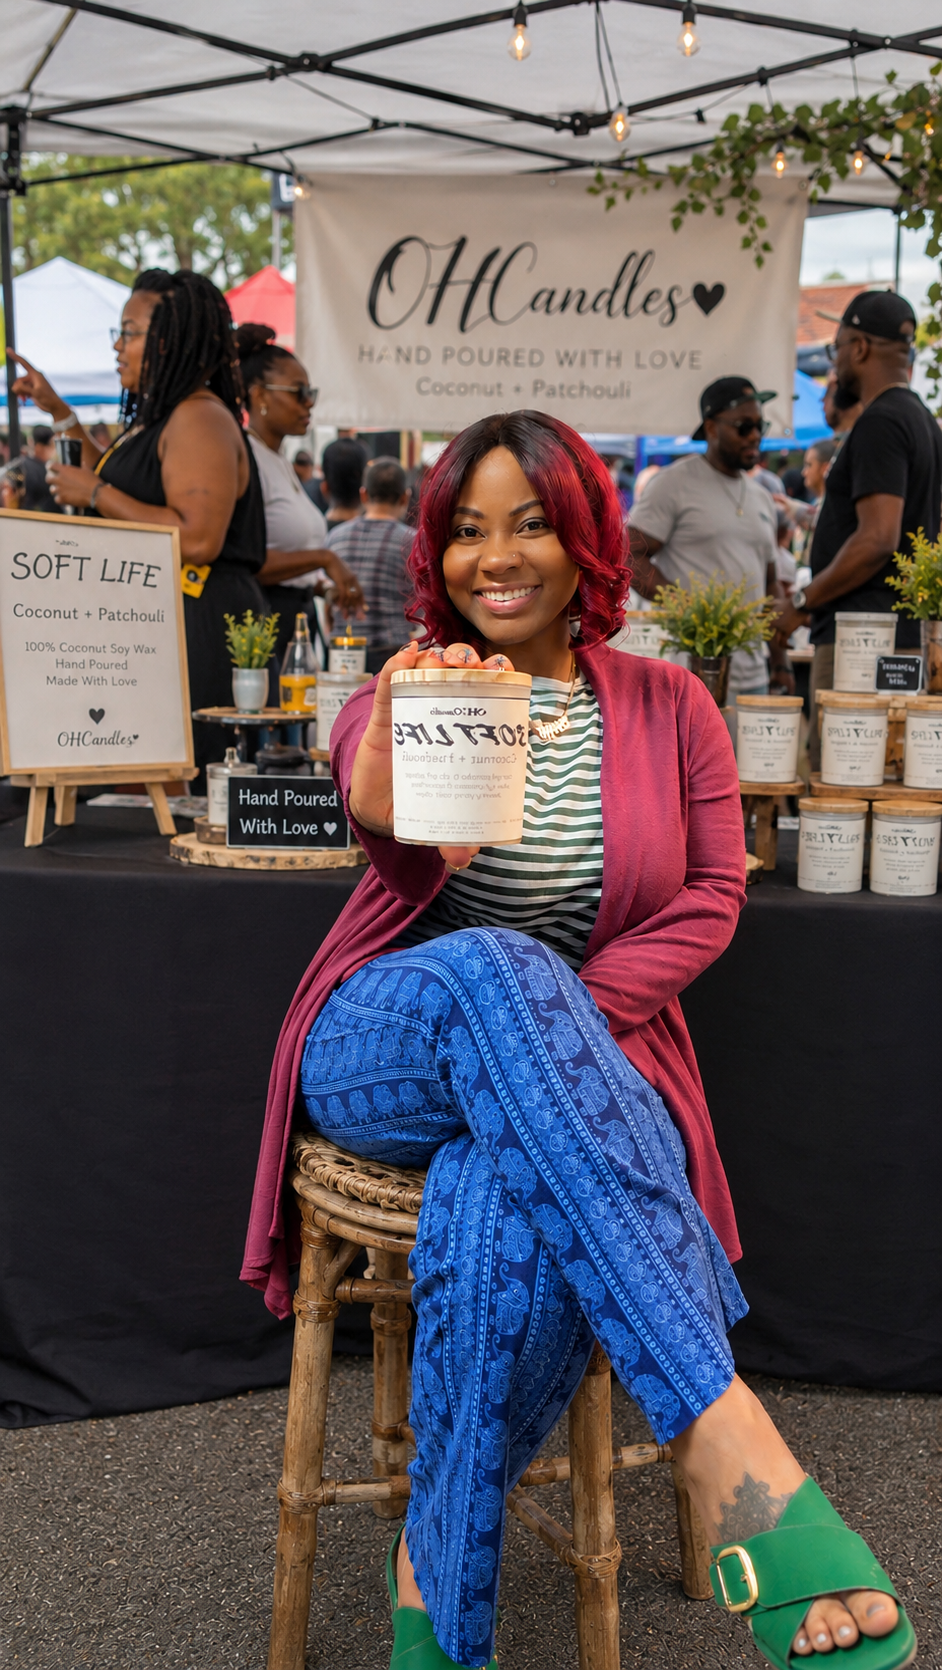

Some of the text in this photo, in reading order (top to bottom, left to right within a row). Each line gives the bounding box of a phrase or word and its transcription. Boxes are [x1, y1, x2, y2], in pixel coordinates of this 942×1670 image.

[367, 234, 692, 333] OHCandles
[358, 344, 702, 371] HAND POURED WITH LOVE
[415, 376, 631, 400] Coconut + Patchouli
[11, 552, 162, 588] SOFT LIFE
[13, 603, 165, 623] Coconut + Patchouli
[25, 641, 157, 656] 100% Coconut Soy Wax
[55, 658, 129, 671] Hand Poured
[46, 675, 138, 687] Made With Love
[57, 731, 134, 748] OHCandles
[238, 789, 338, 807] Hand Poured
[239, 818, 319, 836] With Love
